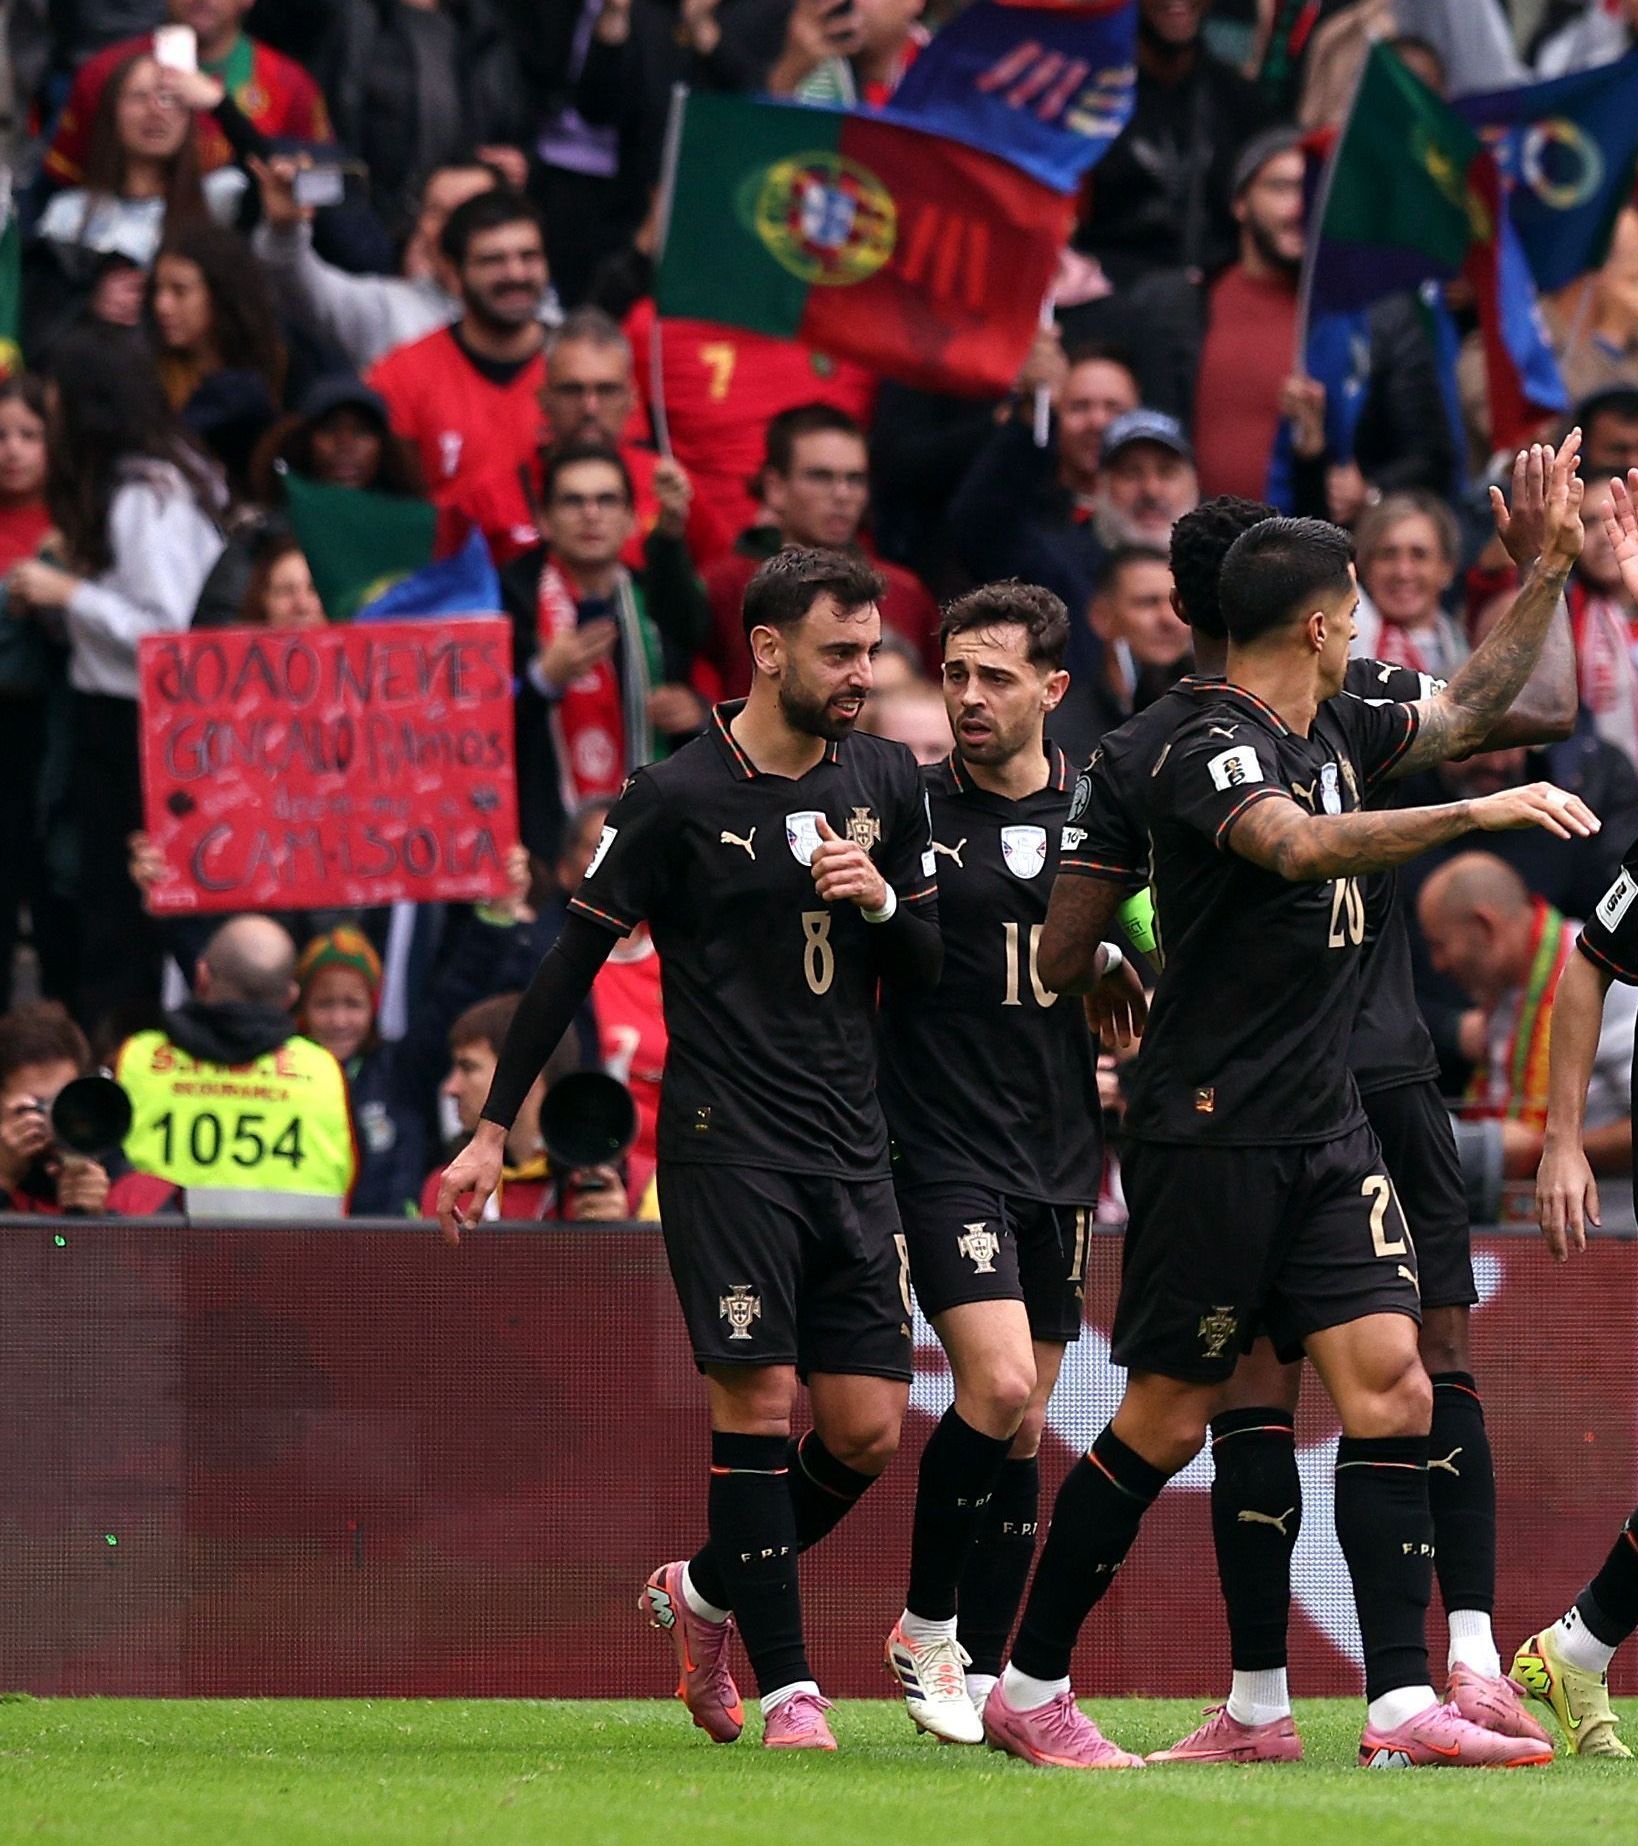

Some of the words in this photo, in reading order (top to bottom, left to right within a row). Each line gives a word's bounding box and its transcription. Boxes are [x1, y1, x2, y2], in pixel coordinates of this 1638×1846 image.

[700, 343, 736, 401] 7
[334, 637, 508, 705] NEVES
[802, 910, 834, 995] 8
[153, 1112, 305, 1169] 1054
